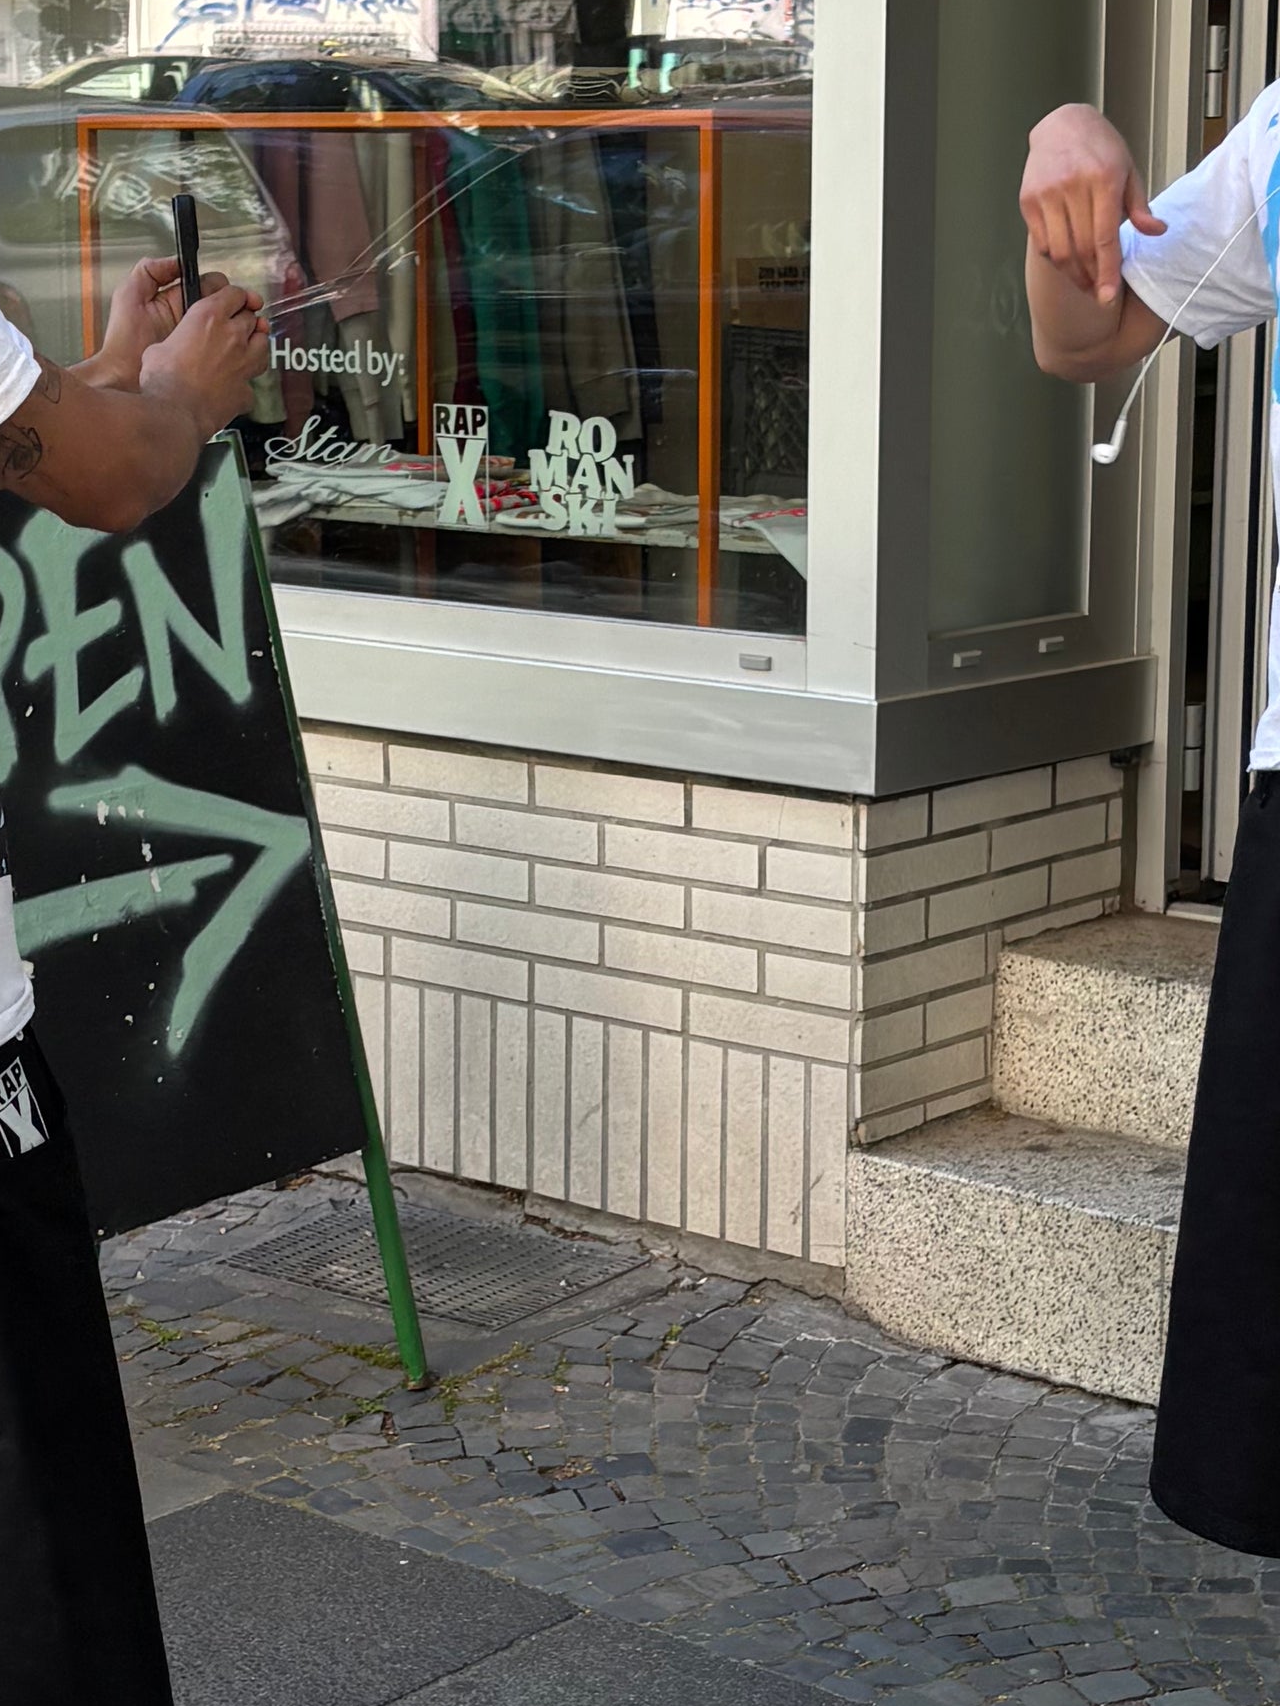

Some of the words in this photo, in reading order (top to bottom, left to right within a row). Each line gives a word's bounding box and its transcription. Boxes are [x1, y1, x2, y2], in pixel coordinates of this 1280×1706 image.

[270, 338, 361, 374] Hosted
[367, 340, 405, 386] by:
[264, 415, 399, 468] Stan
[436, 406, 487, 436] RAP
[437, 438, 486, 525] X
